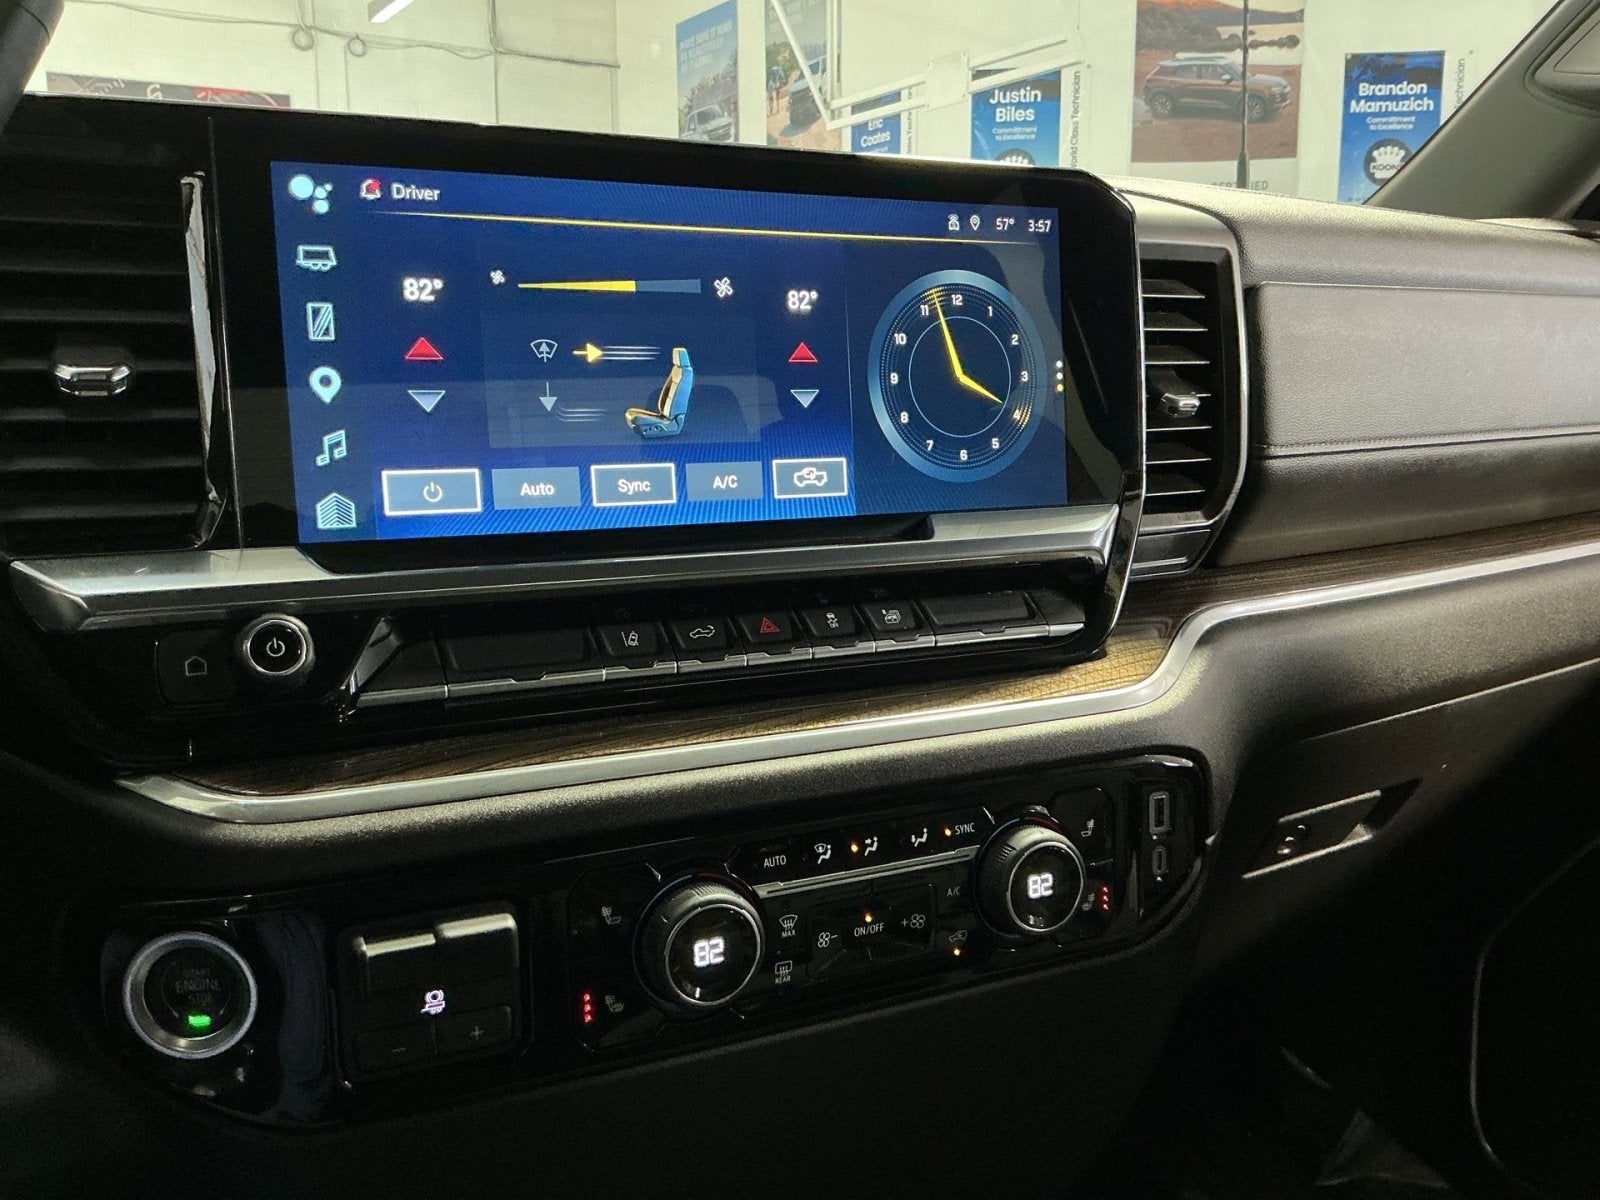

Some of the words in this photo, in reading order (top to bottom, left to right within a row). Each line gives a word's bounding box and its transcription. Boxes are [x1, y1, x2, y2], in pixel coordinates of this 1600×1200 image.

[989, 86, 1041, 104] Justin
[1070, 70, 1080, 119] Technician
[1358, 81, 1427, 96] Brandon
[1350, 97, 1434, 113] Mamuzich
[995, 107, 1035, 122] Biles
[861, 131, 891, 147] Coates
[1070, 120, 1079, 146] Class
[391, 184, 440, 202] Driver
[996, 218, 1015, 231] 57°
[1028, 219, 1052, 232] 3:57
[403, 278, 443, 301] 82°
[787, 290, 818, 310] 82°
[951, 294, 963, 305] 12
[920, 305, 929, 316] 11
[988, 306, 993, 316] 1
[894, 333, 907, 345] 10
[1011, 334, 1019, 345] 2
[890, 373, 899, 385] 9
[1021, 371, 1029, 381] 3
[901, 412, 909, 423] 8
[1013, 409, 1021, 421] 4
[926, 440, 934, 451] 7
[992, 438, 999, 449] 5
[960, 450, 968, 460] 6
[520, 481, 555, 497] Auto
[618, 478, 651, 495] Sync
[713, 475, 738, 490] A/C
[955, 823, 975, 835] SYNC
[763, 855, 787, 868] AUTO
[946, 887, 960, 897] A/C
[1027, 873, 1053, 899] 82
[781, 929, 796, 938] MAX
[854, 923, 884, 937] ON/OFF
[693, 936, 725, 968] 82
